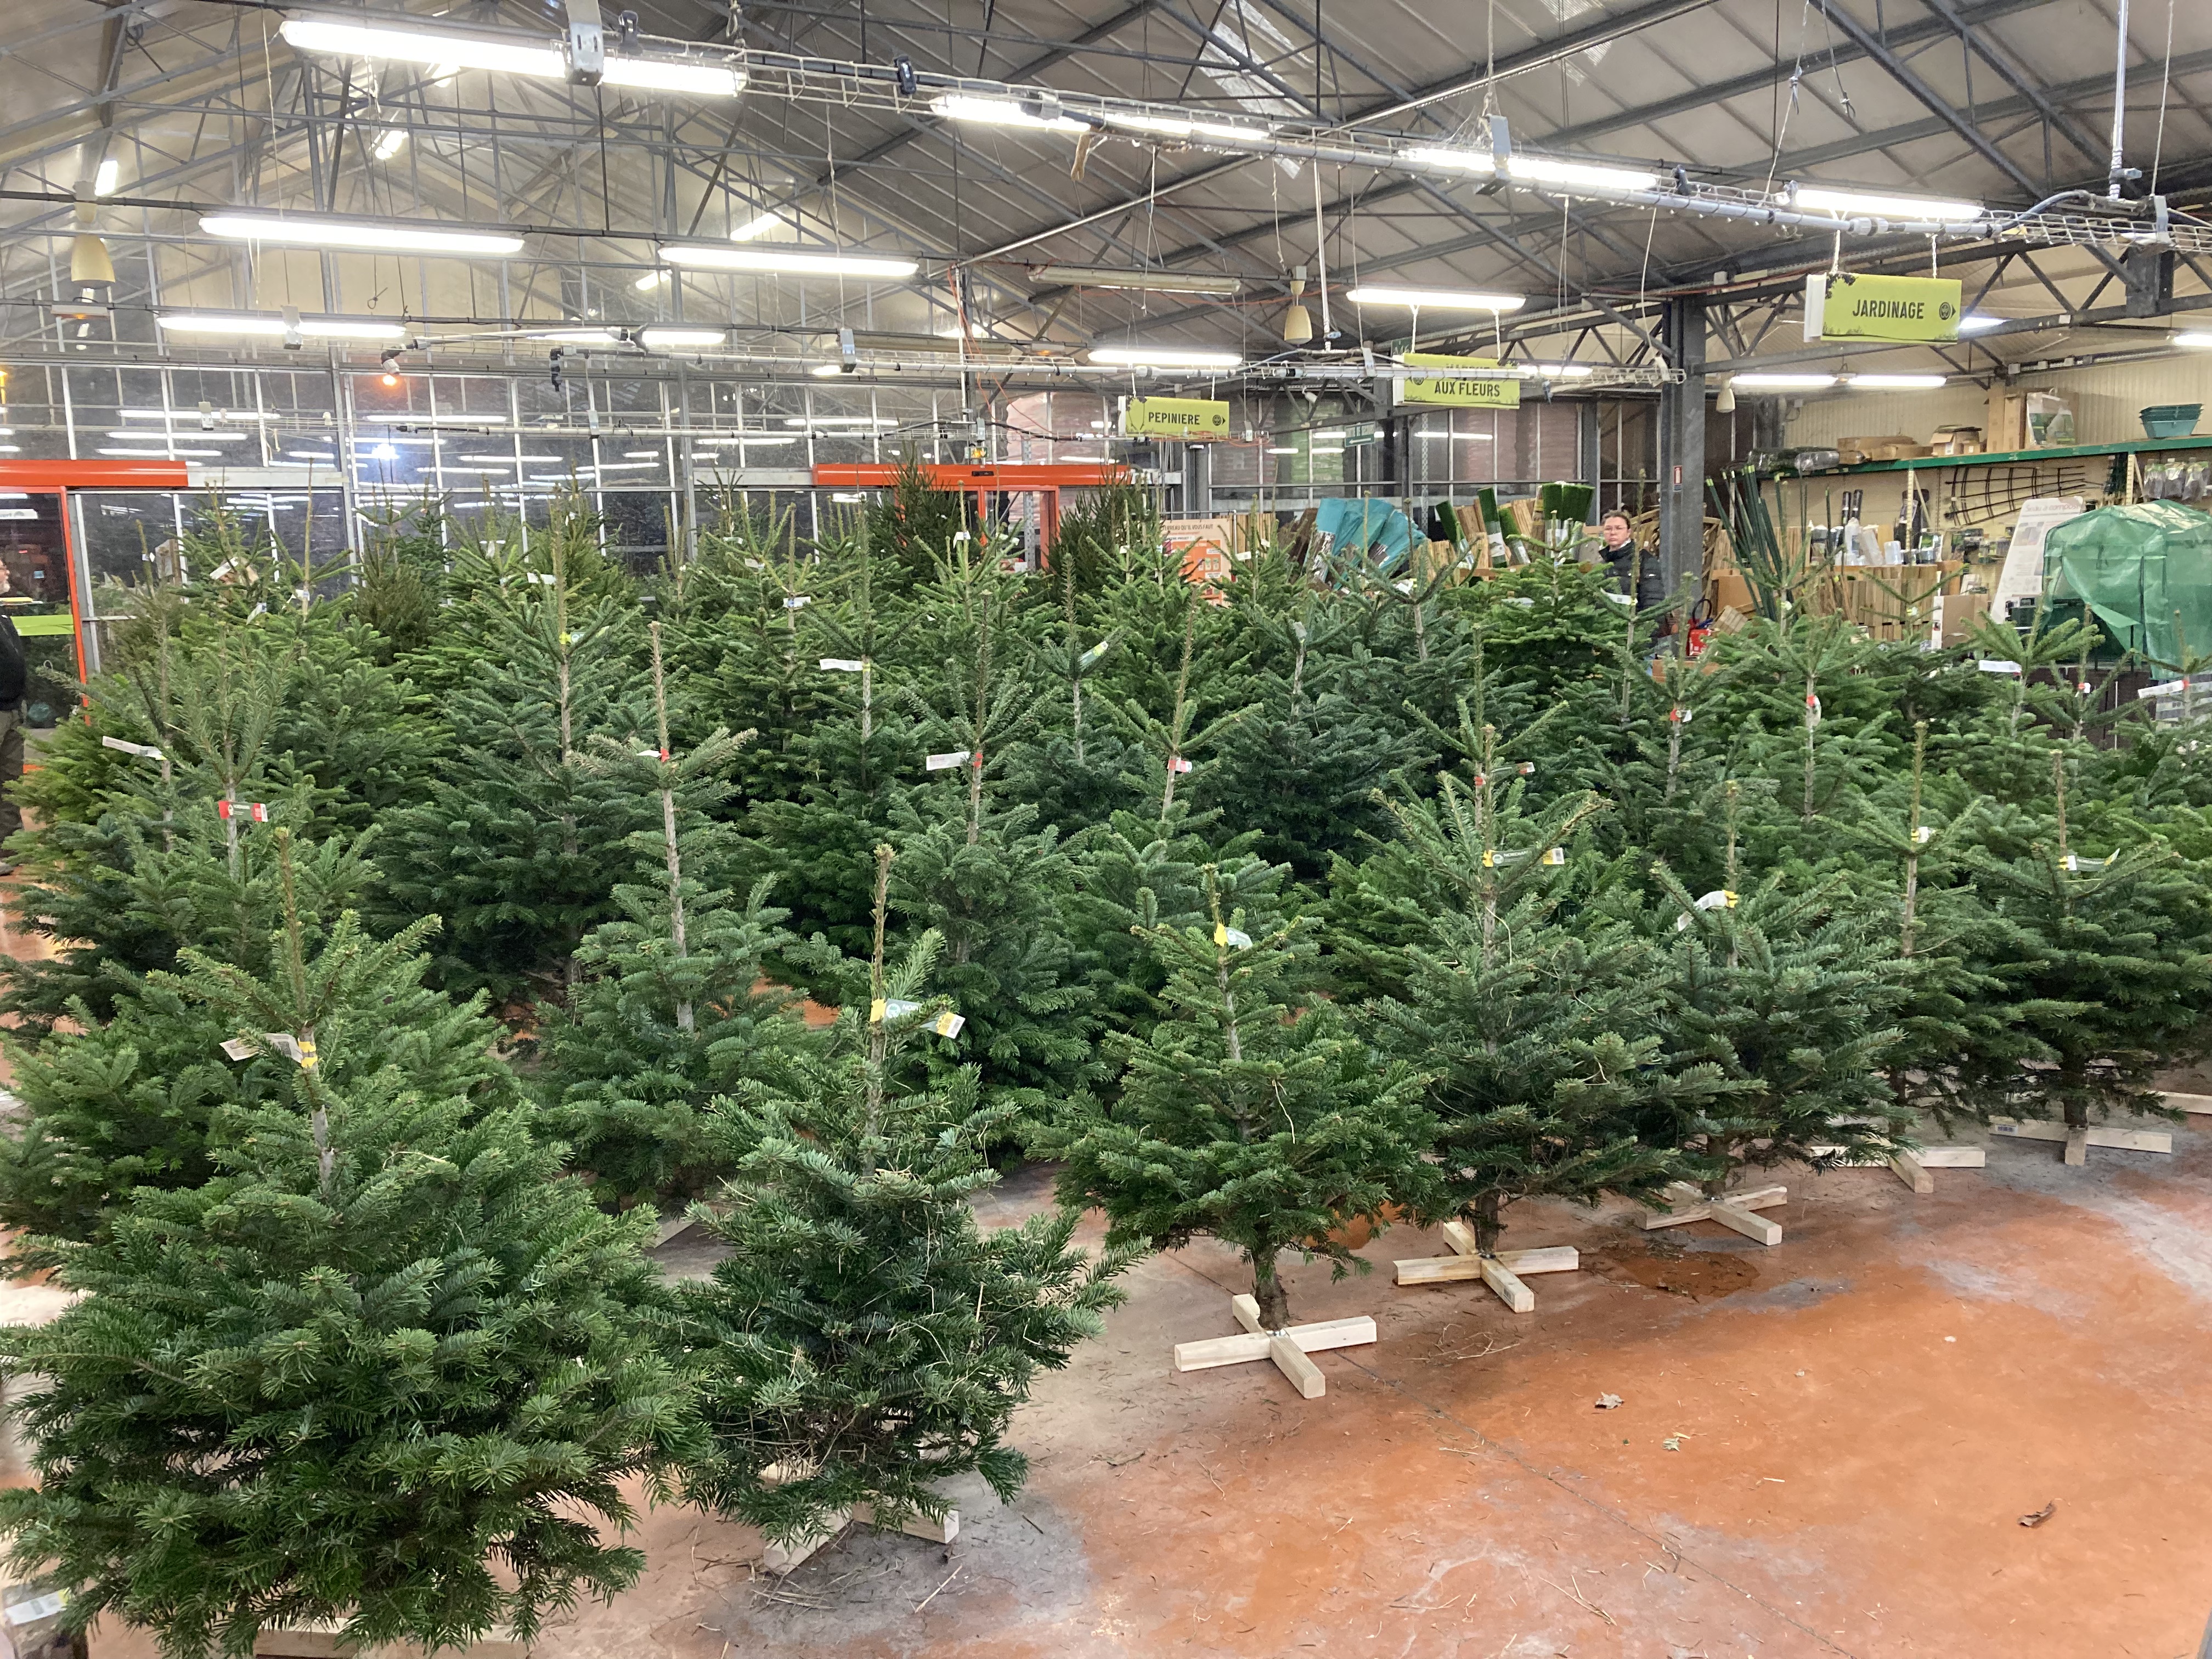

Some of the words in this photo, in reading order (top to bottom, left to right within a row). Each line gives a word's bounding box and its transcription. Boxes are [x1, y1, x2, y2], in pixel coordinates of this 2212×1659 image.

[1852, 299, 1925, 319] JARDINAGE
[1434, 381, 1456, 395] AUX
[1459, 382, 1500, 397] FLEURS
[1148, 412, 1200, 425] PEPINIERE
